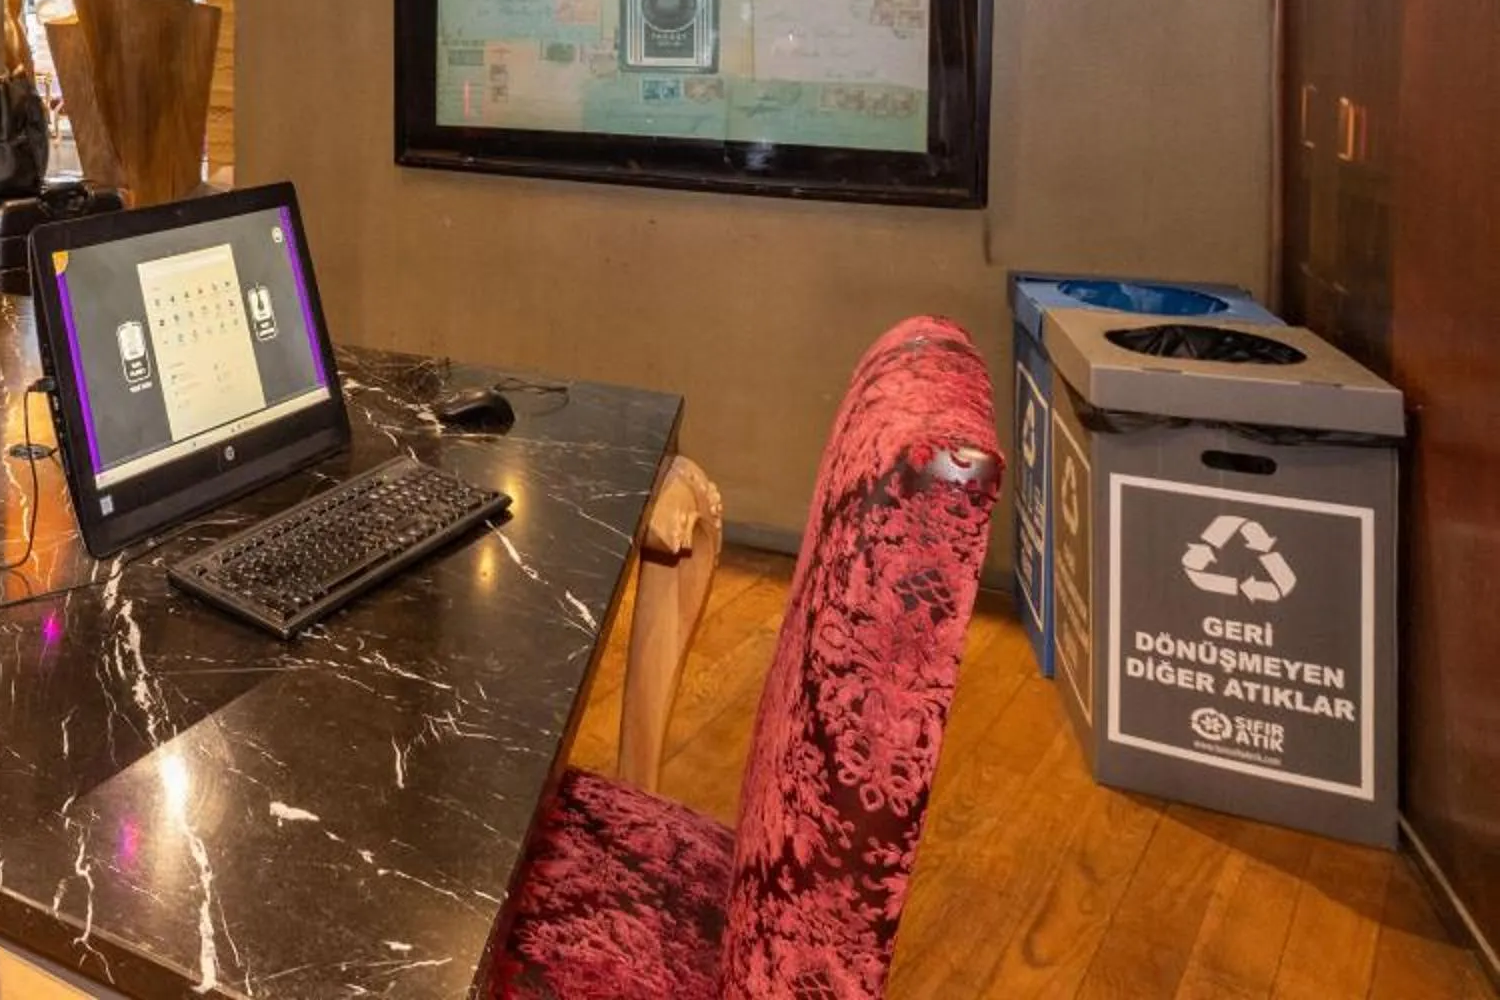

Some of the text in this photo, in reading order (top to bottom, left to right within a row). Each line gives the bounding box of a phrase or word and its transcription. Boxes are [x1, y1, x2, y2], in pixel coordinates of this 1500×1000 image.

[1202, 615, 1274, 647] GERİ
[1135, 630, 1346, 690] DÖNÜŞMEYEN
[1125, 656, 1356, 722] DİĞER ATIKLAR
[1234, 715, 1285, 738] SIFIR
[1235, 728, 1285, 753] ATIK
